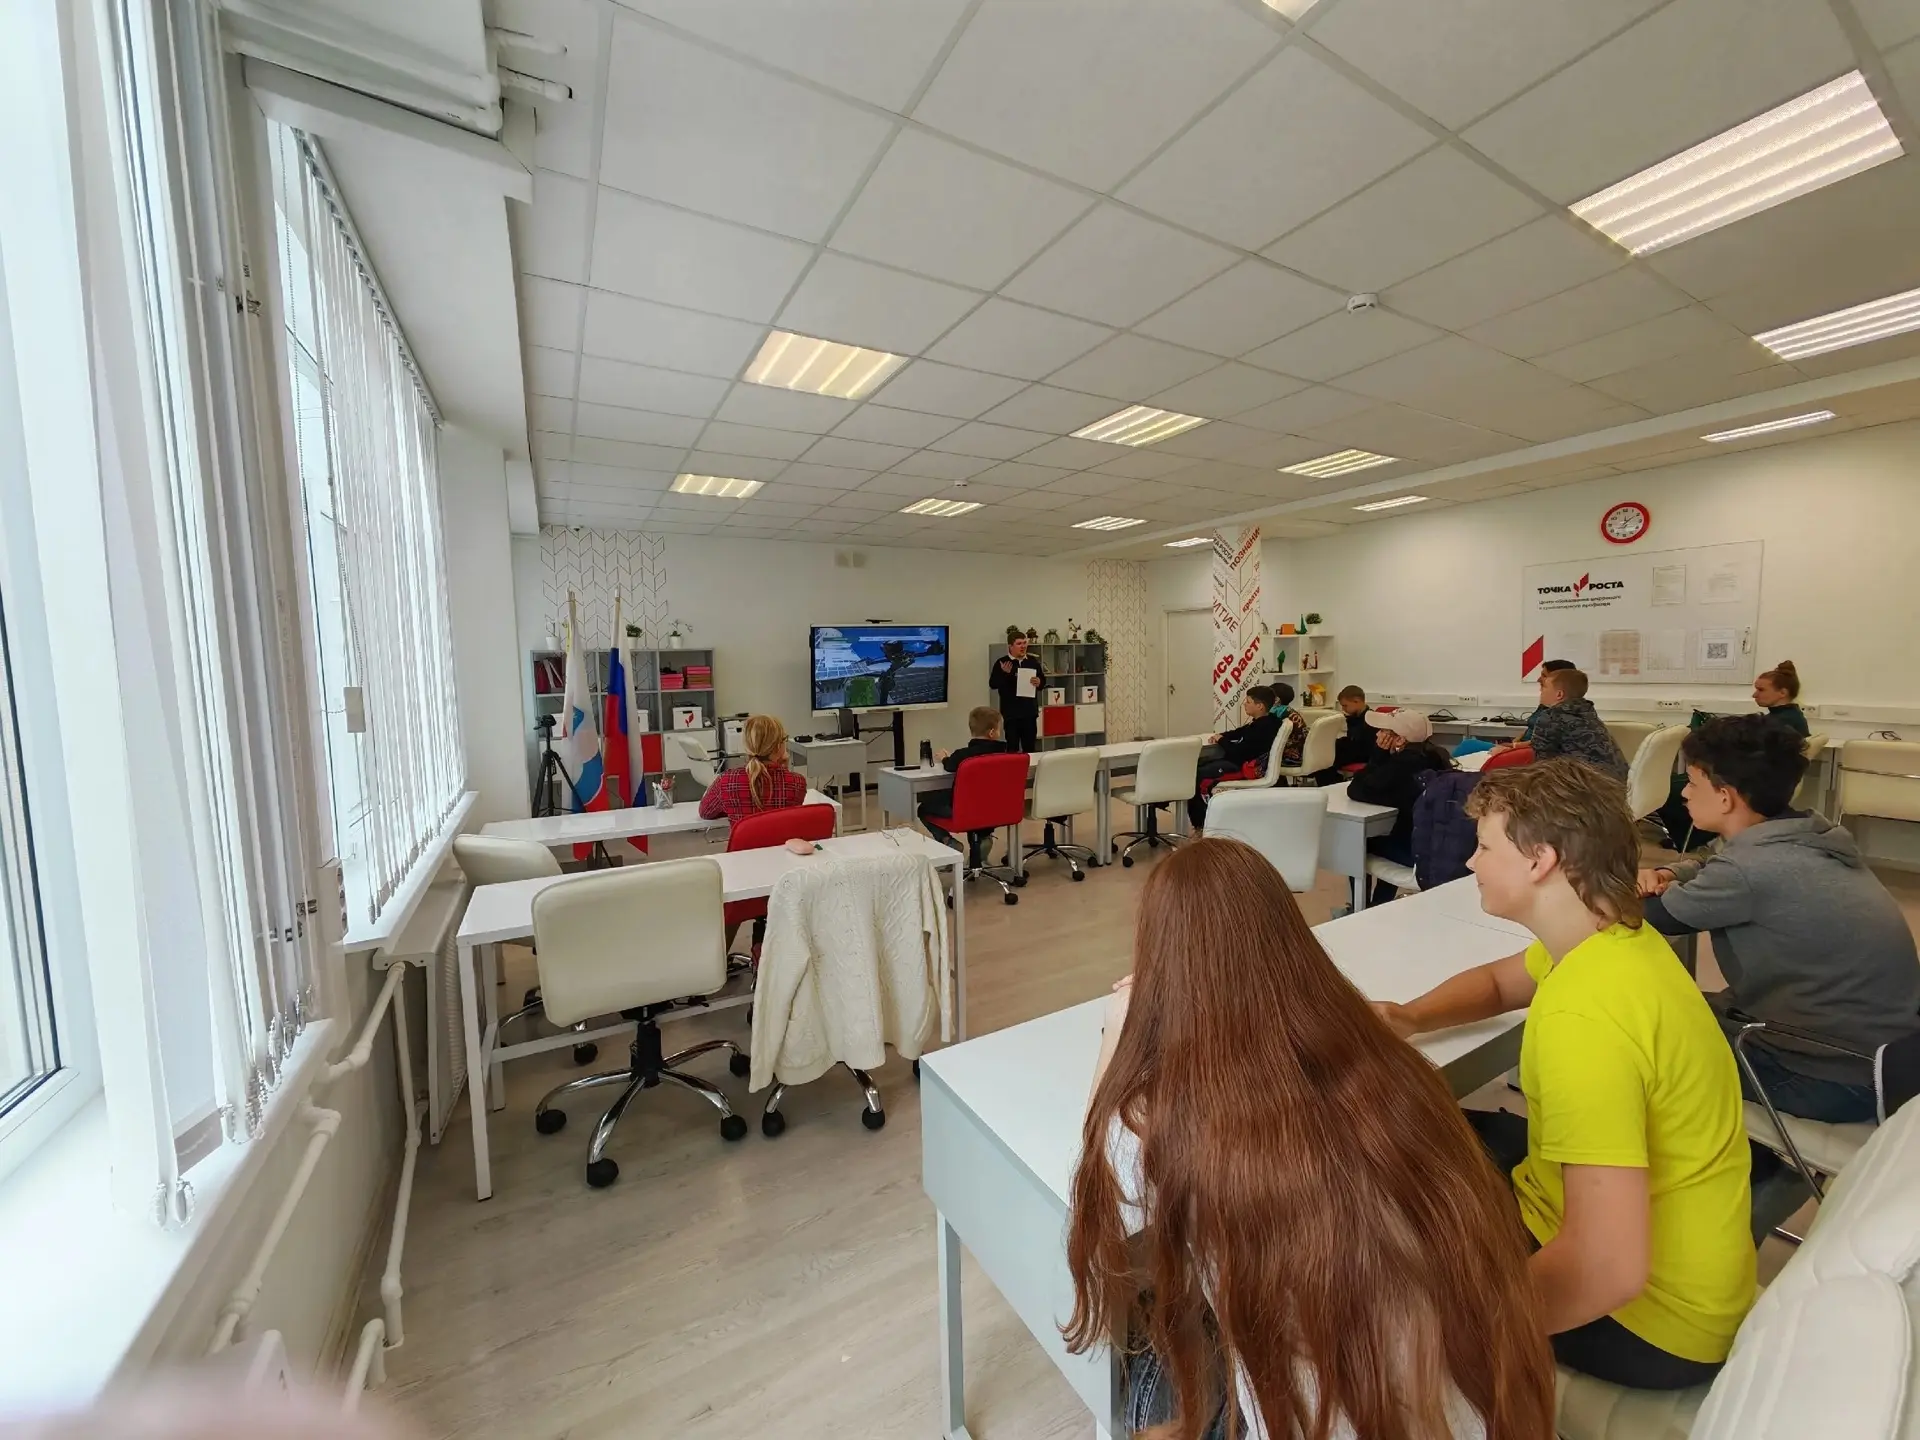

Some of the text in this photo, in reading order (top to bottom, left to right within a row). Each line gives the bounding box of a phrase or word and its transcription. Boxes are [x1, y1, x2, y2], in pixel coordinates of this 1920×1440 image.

[1537, 581, 1624, 594] ТОЧКА РОСТА
[1213, 597, 1239, 633] ИТИЕ
[1220, 678, 1233, 695] и
